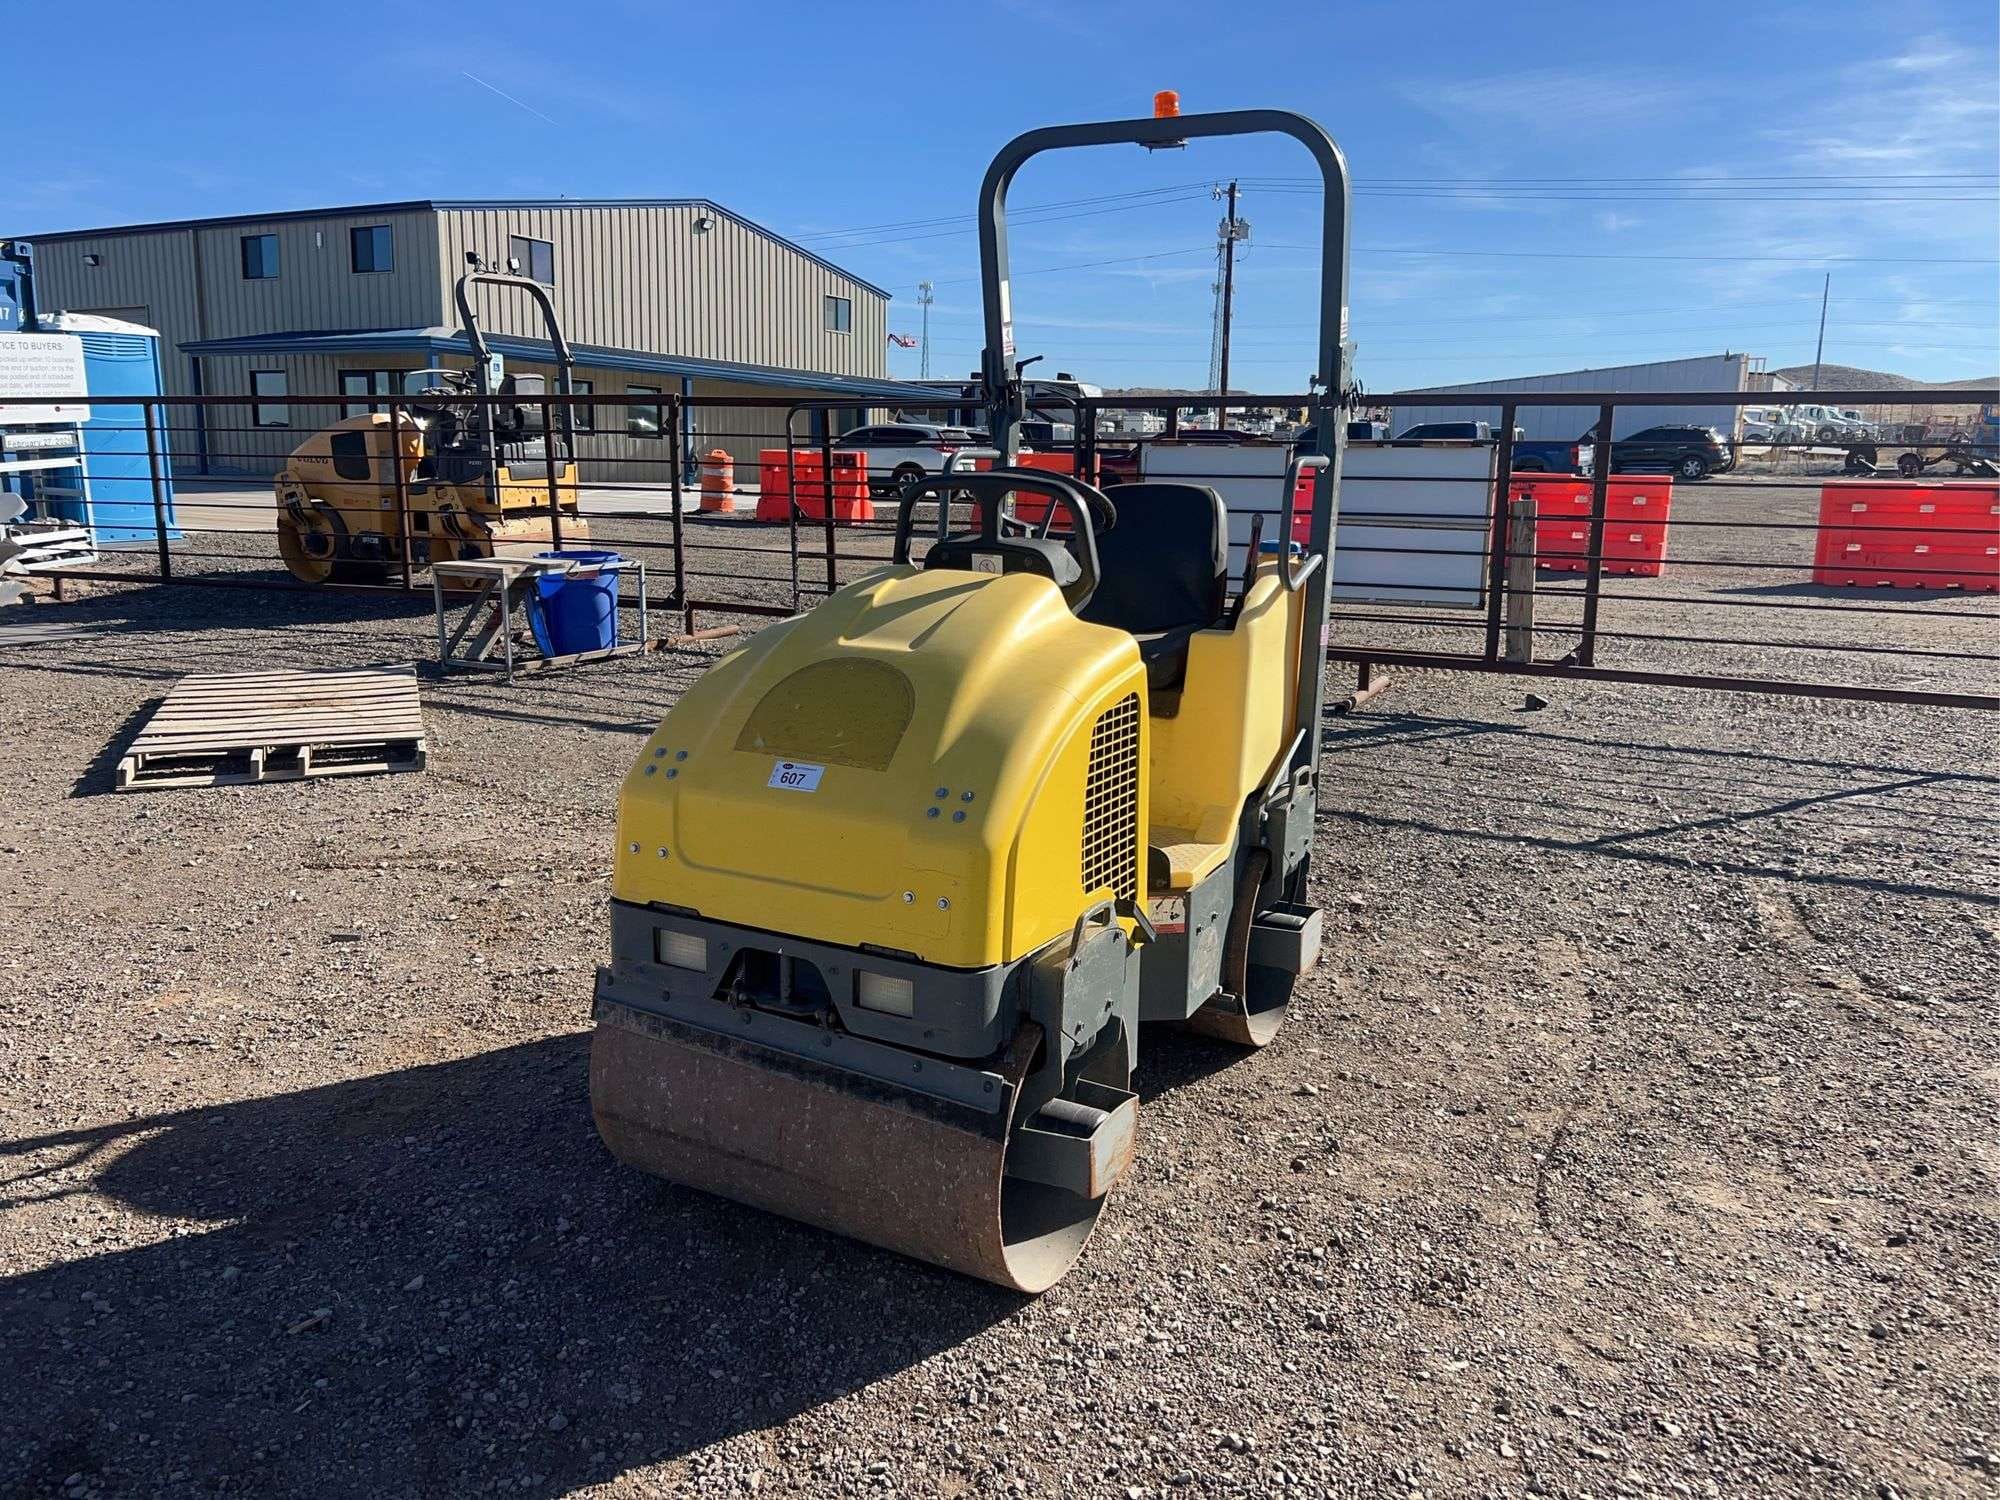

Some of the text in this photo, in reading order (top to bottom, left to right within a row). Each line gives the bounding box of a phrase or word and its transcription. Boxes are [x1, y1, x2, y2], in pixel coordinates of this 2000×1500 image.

[18, 341, 29, 350] TO
[31, 342, 65, 351] BUYERS:
[780, 772, 807, 785] 607
